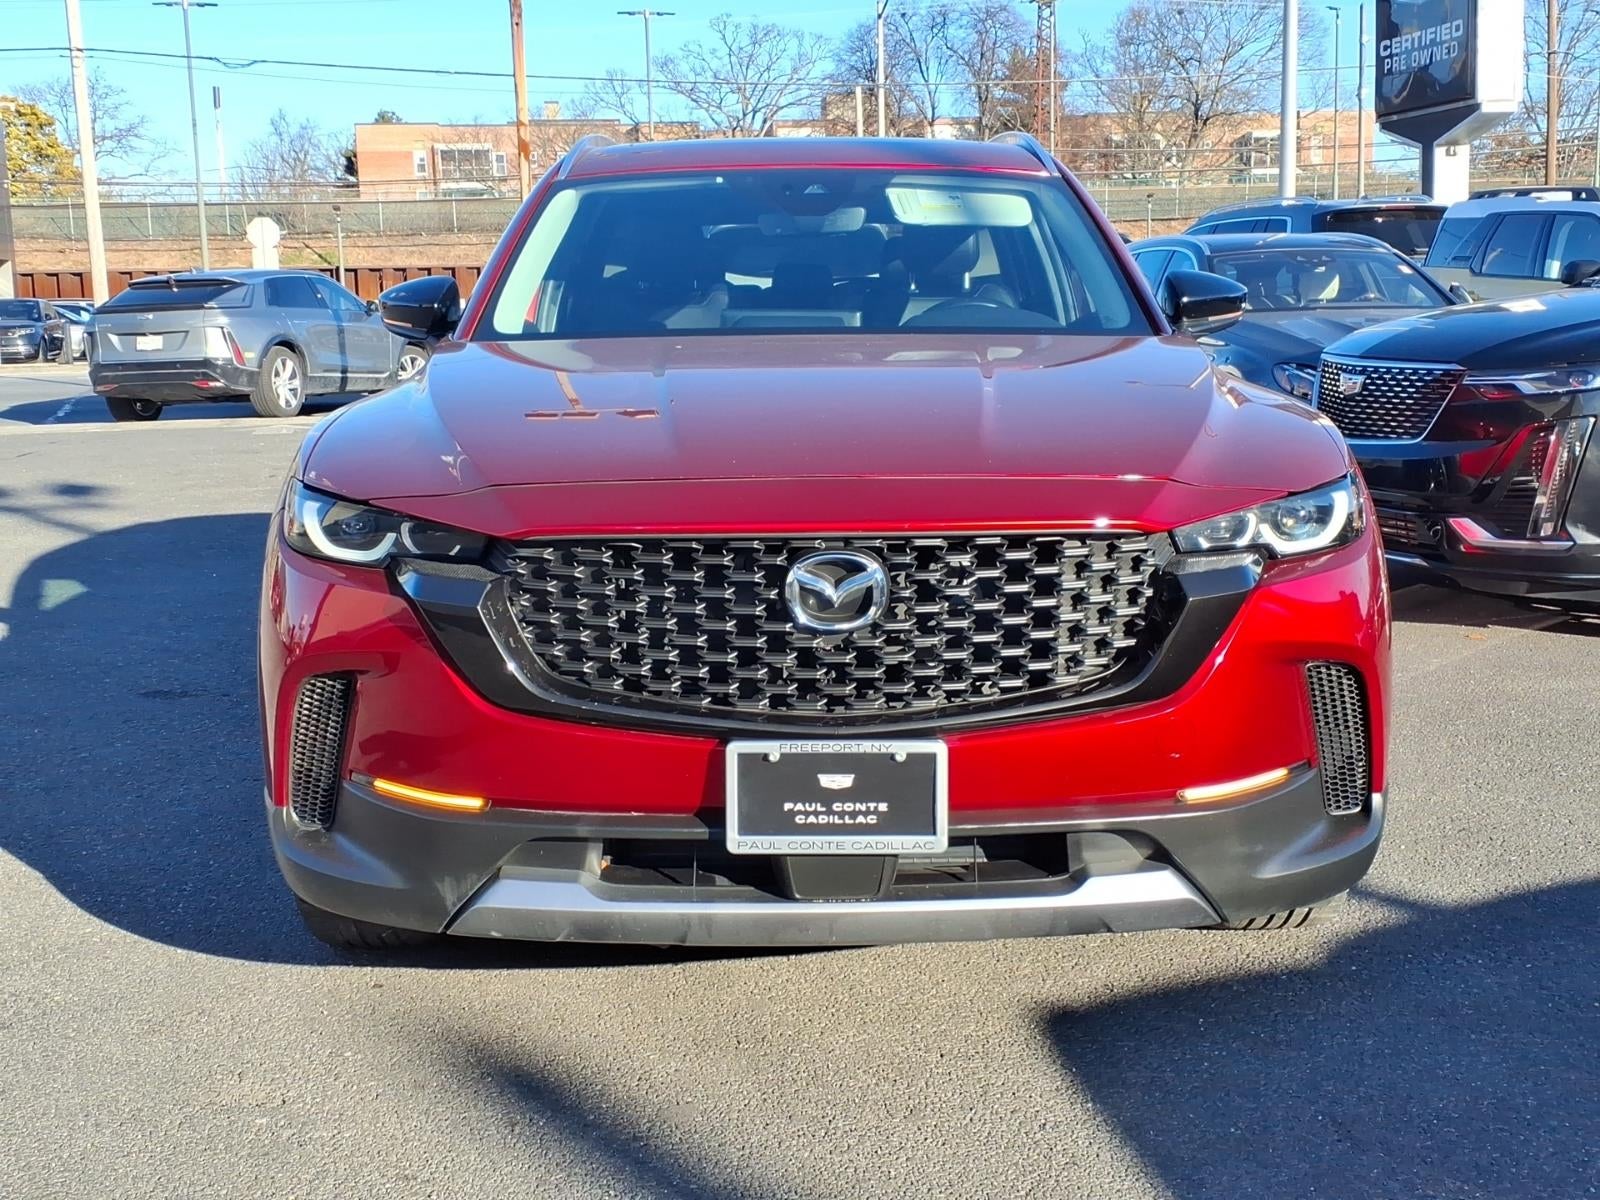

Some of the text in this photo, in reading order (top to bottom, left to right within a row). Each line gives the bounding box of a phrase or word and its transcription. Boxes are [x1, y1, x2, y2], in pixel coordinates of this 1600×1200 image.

[1380, 19, 1463, 56] CERTIFIED
[1384, 41, 1458, 74] PRE OWNED
[779, 743, 893, 753] FREEPORT, NY
[784, 802, 888, 812] PAUL CONTE
[794, 814, 877, 824] CADILLAC
[737, 841, 935, 850] PAUL CONTE CADILLAC
